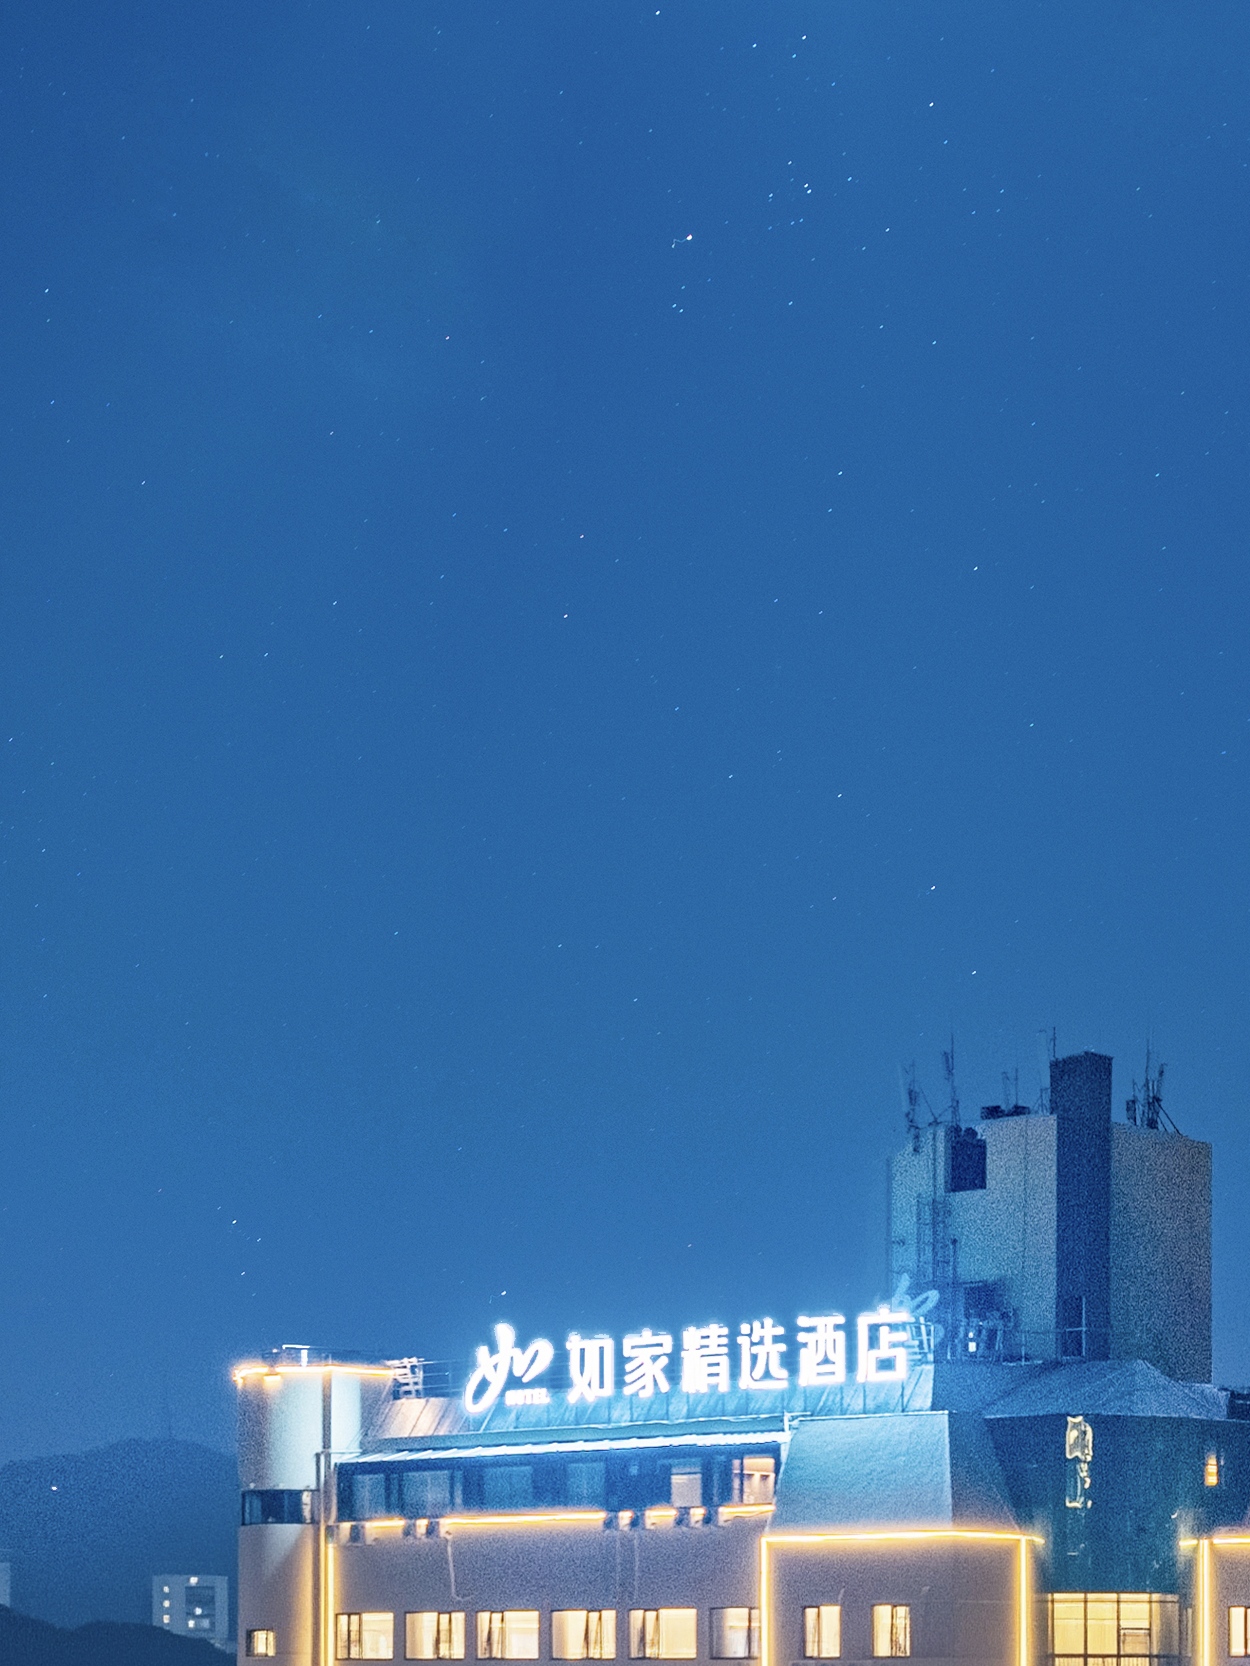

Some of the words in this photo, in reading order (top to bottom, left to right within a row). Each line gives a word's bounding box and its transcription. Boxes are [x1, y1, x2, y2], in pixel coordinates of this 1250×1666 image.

[566, 1304, 911, 1403] 如家精选酒店
